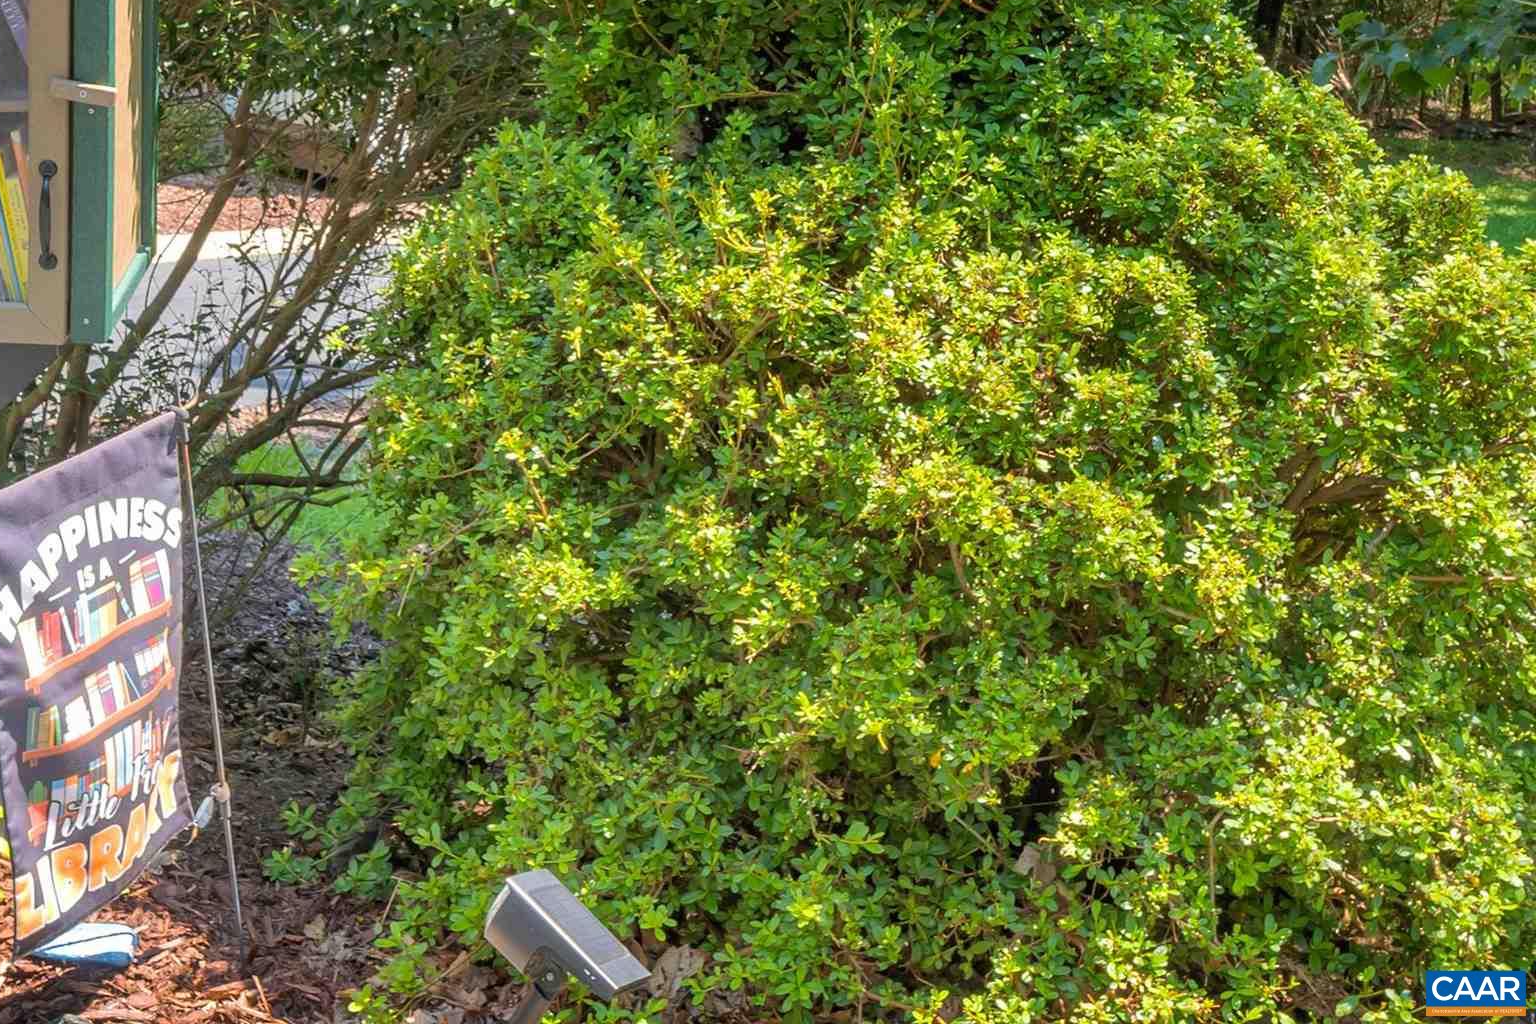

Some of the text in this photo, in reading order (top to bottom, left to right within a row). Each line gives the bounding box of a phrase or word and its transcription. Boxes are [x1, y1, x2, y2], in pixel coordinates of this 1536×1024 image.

[76, 556, 113, 592] IS A
[43, 783, 121, 851] Little
